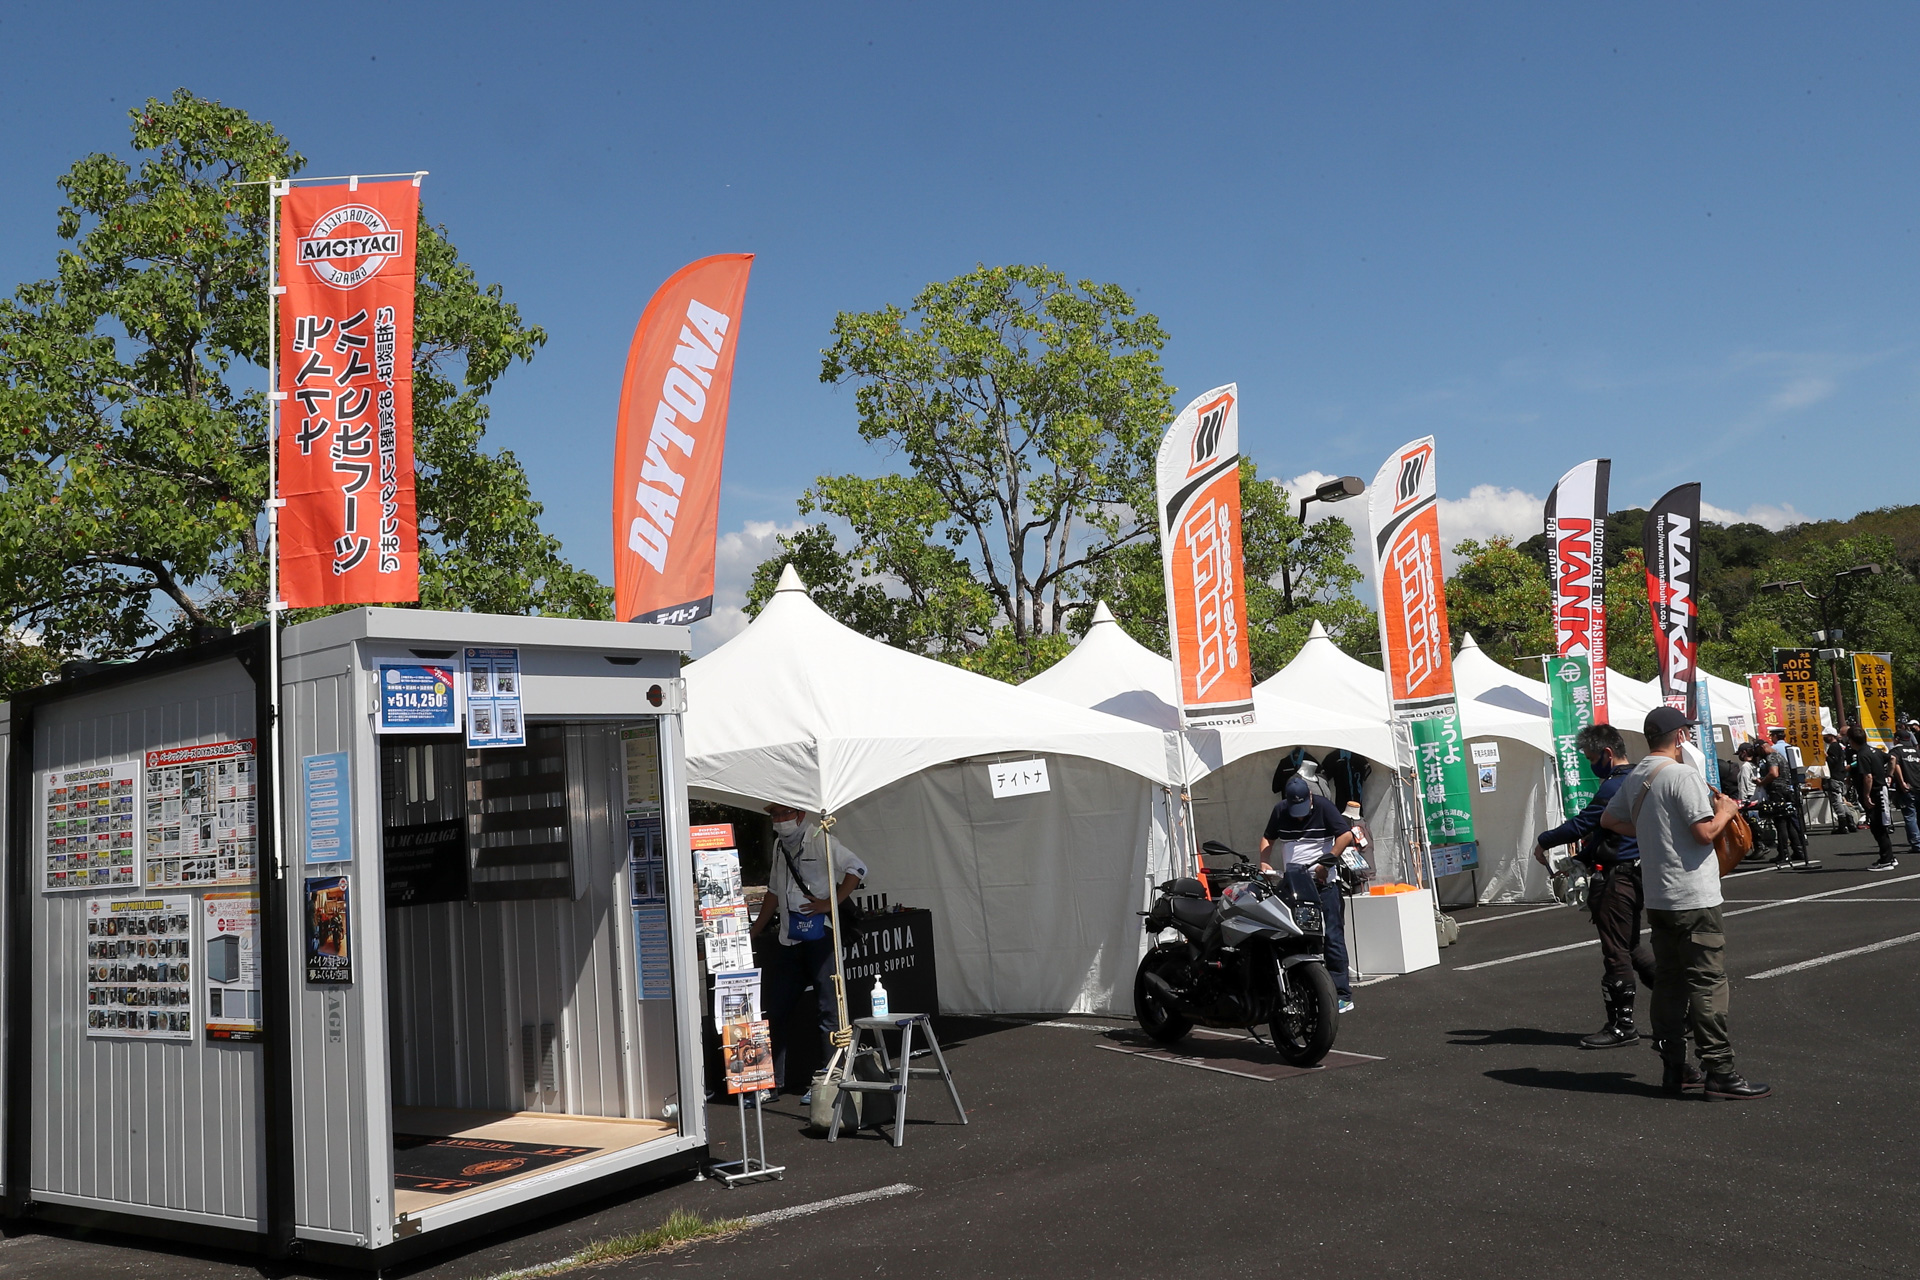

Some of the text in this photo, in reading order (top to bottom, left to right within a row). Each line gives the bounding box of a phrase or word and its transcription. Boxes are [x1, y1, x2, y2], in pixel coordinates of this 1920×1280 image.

[629, 299, 730, 575] DAYTONA
[1547, 517, 1556, 539] FOR
[1557, 518, 1592, 658] NANK
[1657, 515, 1668, 630] http://www.nankaibuhin.co.jp
[657, 606, 700, 625] デイトナ
[1592, 518, 1606, 707] MOTORCYCLE TOP FASHION LEADER
[1667, 512, 1692, 693] NANKAI
[387, 693, 442, 708] ¥514,250
[997, 770, 1042, 788] デイトナ
[1420, 742, 1446, 804] 天浜線
[1558, 734, 1581, 787] 天浜線
[842, 925, 914, 961] AYTONA
[846, 954, 916, 980] UTDOOR SUPPLY
